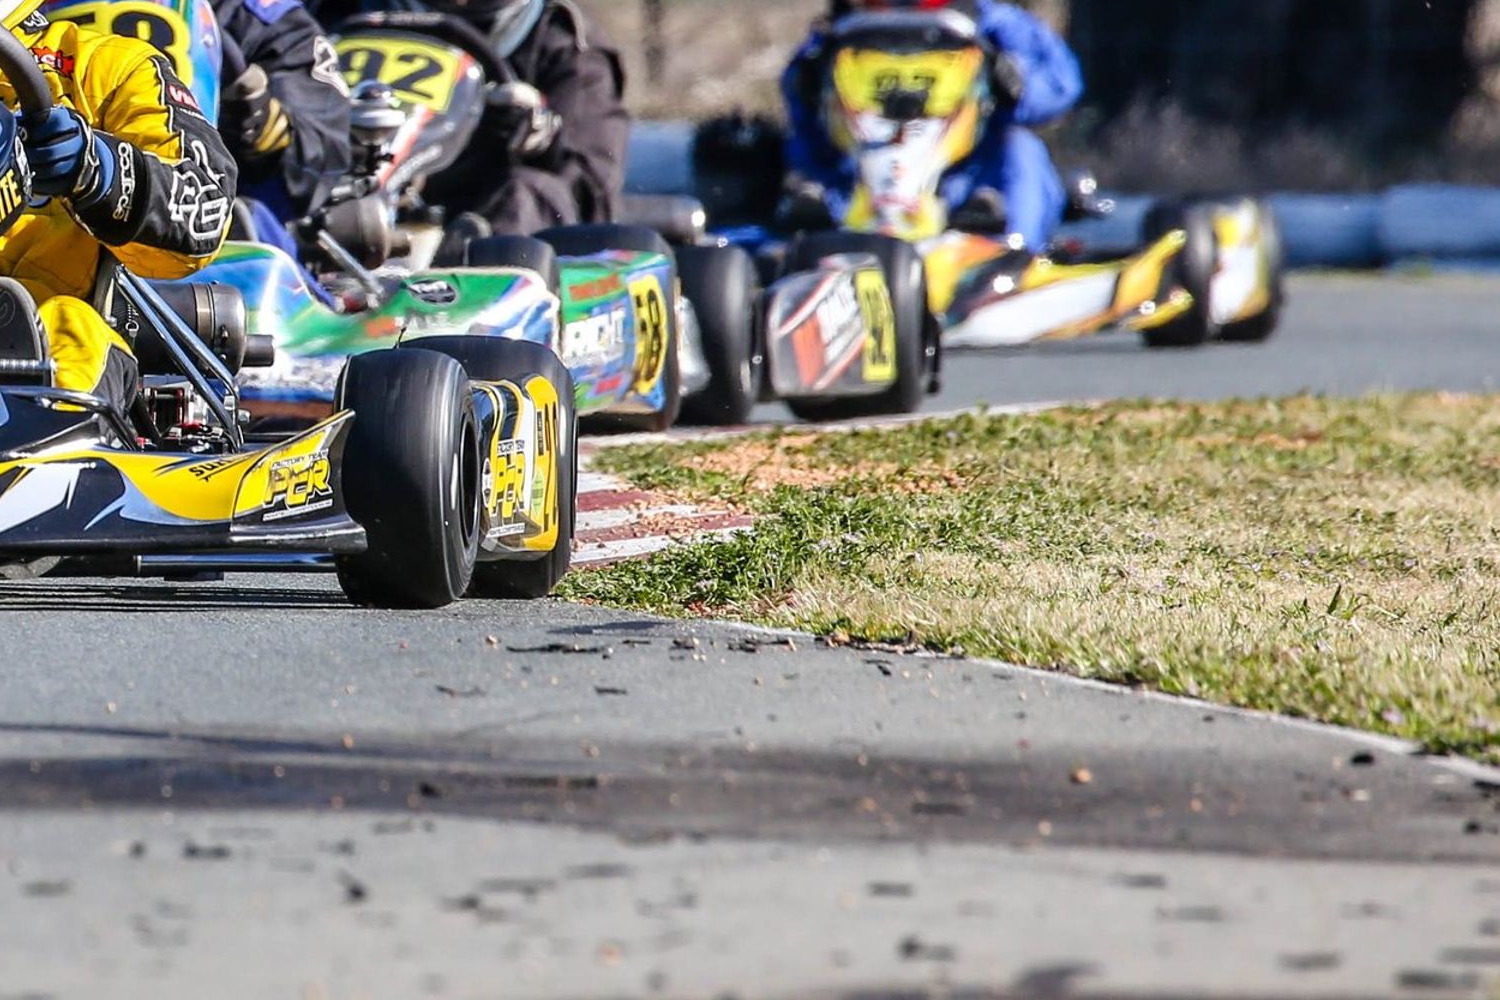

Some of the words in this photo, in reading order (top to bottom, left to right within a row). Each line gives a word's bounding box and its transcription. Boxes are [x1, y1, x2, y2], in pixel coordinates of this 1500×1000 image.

[338, 48, 444, 100] 92
[112, 141, 136, 222] sparco
[263, 459, 332, 507] PCR
